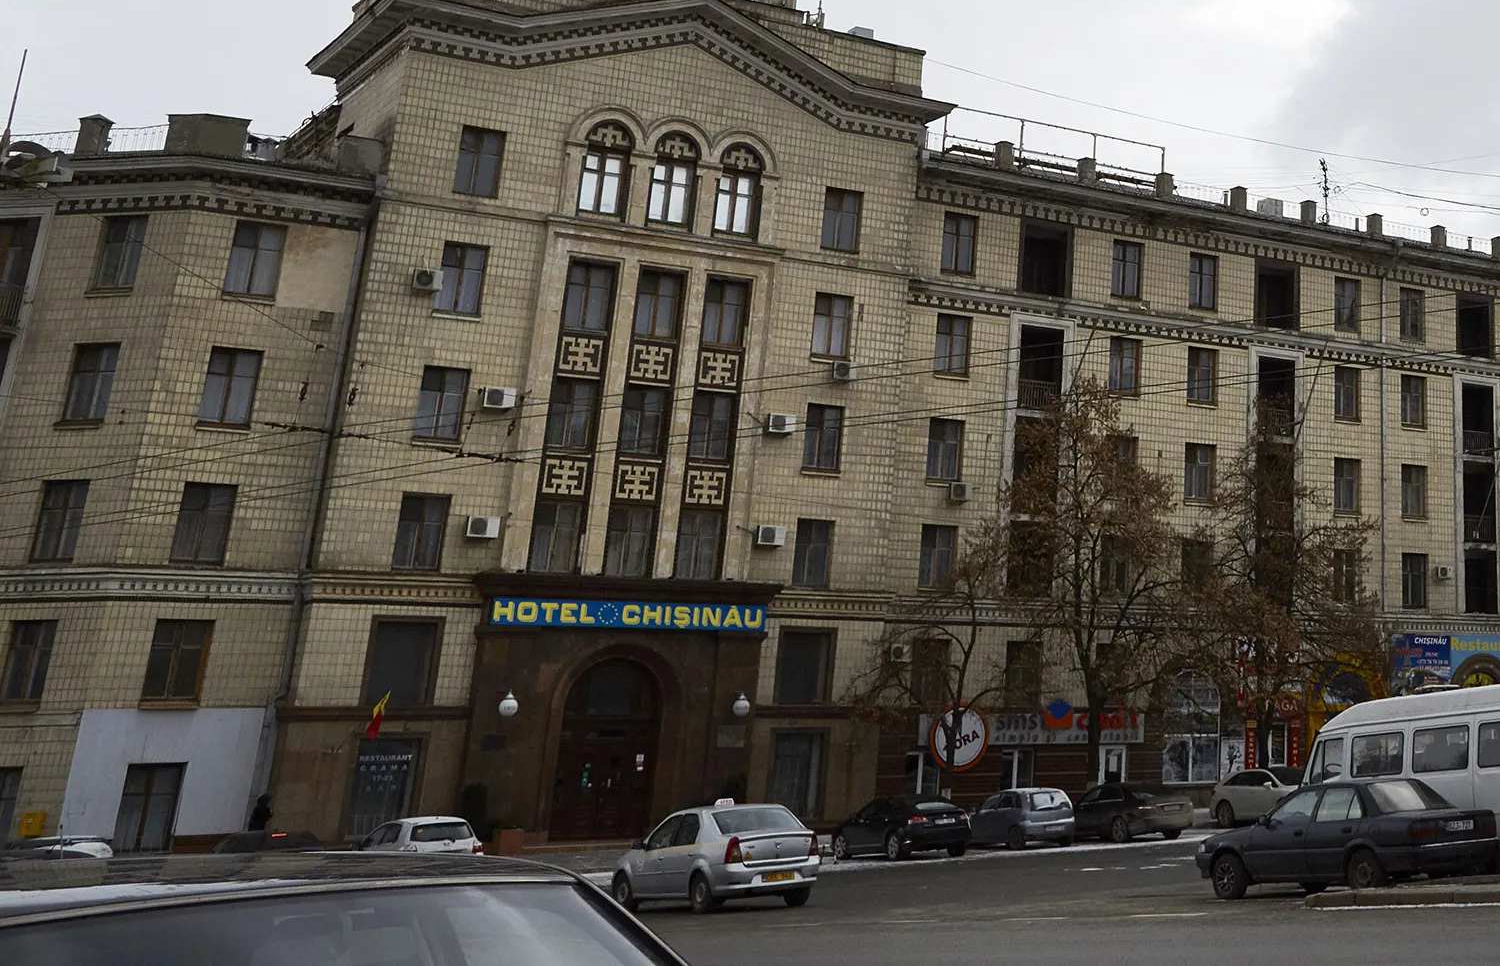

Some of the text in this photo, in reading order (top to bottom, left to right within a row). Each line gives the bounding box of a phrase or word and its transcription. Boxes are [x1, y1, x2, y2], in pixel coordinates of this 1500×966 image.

[492, 601, 596, 624] HOTEL
[996, 714, 1038, 731] sms
[1077, 709, 1139, 730] cedit
[943, 730, 980, 752] ORA
[359, 754, 413, 762] RESTAURANT
